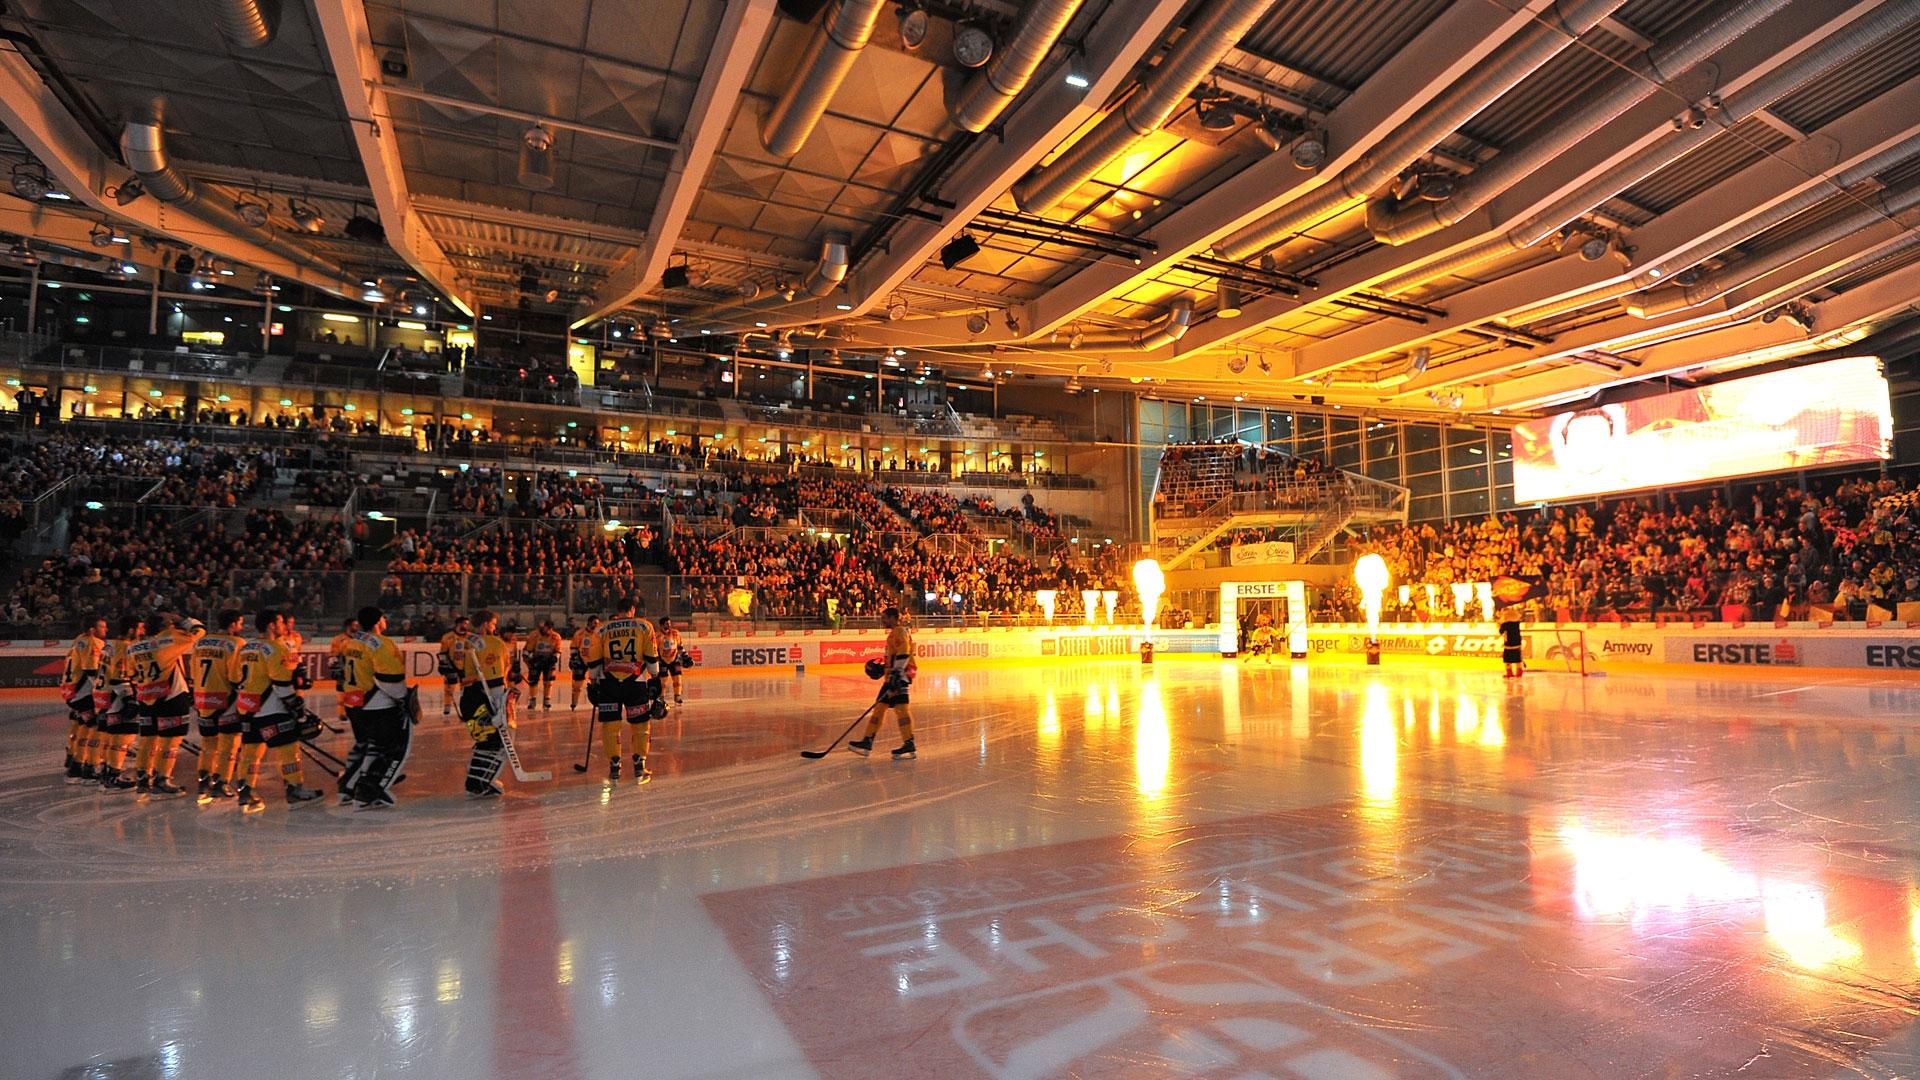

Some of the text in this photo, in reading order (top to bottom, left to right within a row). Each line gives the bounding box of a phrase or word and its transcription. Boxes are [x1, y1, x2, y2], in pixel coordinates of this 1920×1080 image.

[1237, 585, 1276, 595] ERSTE
[609, 638, 637, 662] 64
[731, 648, 787, 665] ERSTE
[1603, 640, 1653, 655] Amway
[1693, 643, 1770, 664] ERSTE
[201, 659, 212, 687] 7
